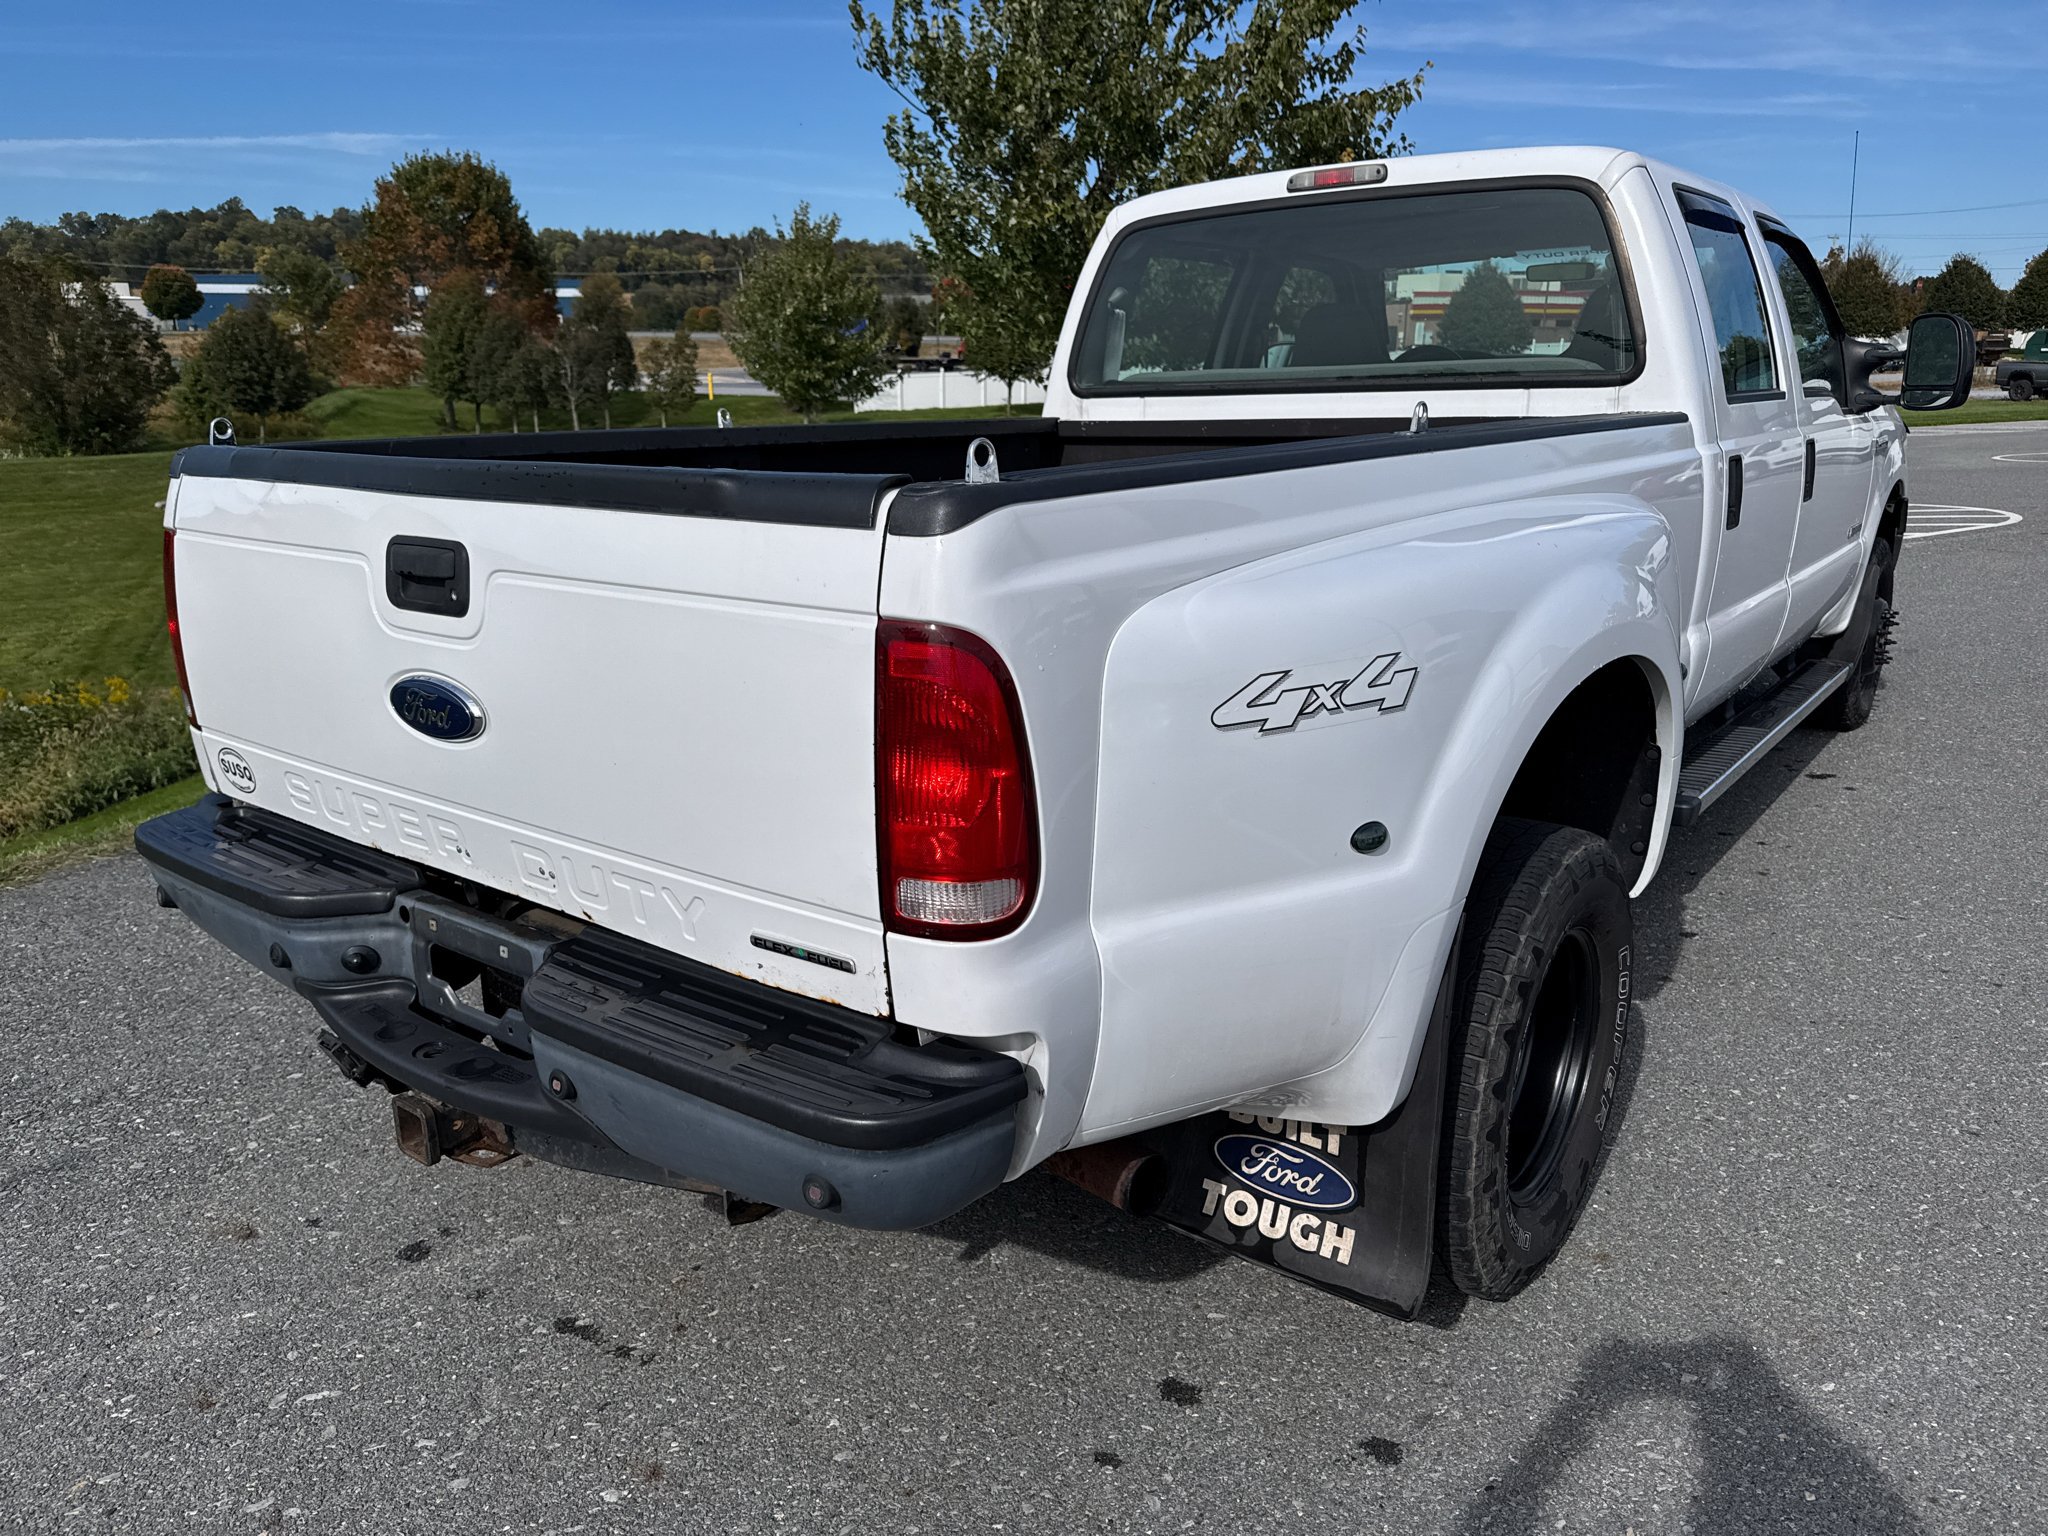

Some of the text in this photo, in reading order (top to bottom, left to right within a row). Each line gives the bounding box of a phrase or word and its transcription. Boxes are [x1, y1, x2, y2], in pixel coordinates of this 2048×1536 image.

[403, 687, 452, 729] Ford
[1211, 652, 1419, 736] 4x4
[221, 758, 255, 784] SUSQ
[284, 771, 706, 942] SUPER DUTY
[753, 937, 851, 974] FLEX FUEL
[1595, 945, 1630, 1132] COOPER
[1229, 1111, 1348, 1157] ILT
[1241, 1143, 1324, 1196] Ford
[1202, 1177, 1356, 1266] TOUGH
